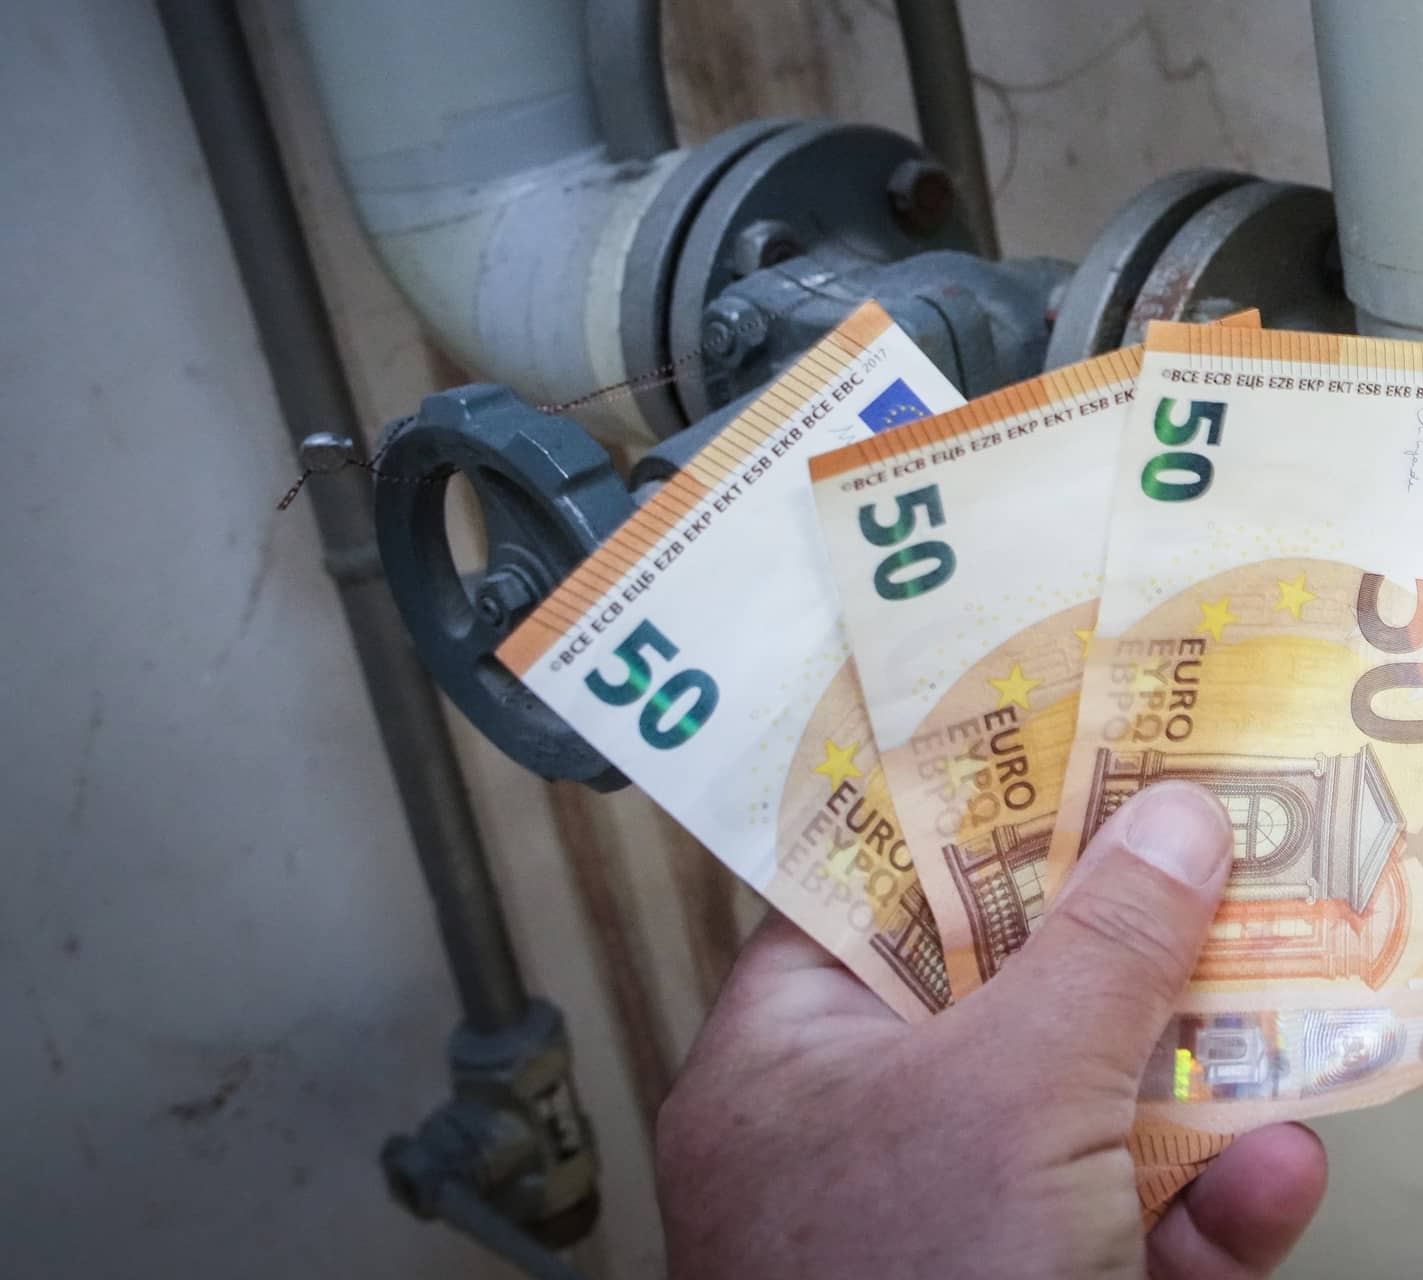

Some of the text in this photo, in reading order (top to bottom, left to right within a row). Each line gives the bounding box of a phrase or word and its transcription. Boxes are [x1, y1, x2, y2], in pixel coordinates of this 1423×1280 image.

[893, 457, 927, 478] ECB
[970, 432, 1003, 452] EZB
[1007, 420, 1039, 441] EKP
[1079, 397, 1110, 417] ESB
[1114, 388, 1137, 406] EK
[1204, 372, 1233, 387] ECB
[1269, 377, 1295, 390] EZB
[1299, 378, 1325, 393] EKP
[1357, 382, 1382, 396] ESB
[1385, 385, 1412, 398] EKB
[591, 602, 624, 634] ECB
[653, 541, 684, 572] EZB
[683, 511, 714, 543] EKP
[742, 455, 772, 486] ESB
[771, 427, 804, 459] EKB
[831, 372, 864, 403] EBC
[862, 348, 888, 375] 2017
[1140, 397, 1229, 503] 50
[857, 482, 958, 602] 50
[584, 617, 720, 751] 50
[1165, 638, 1207, 744] EURO
[983, 705, 1036, 811] EURO
[826, 780, 915, 873] EURO
